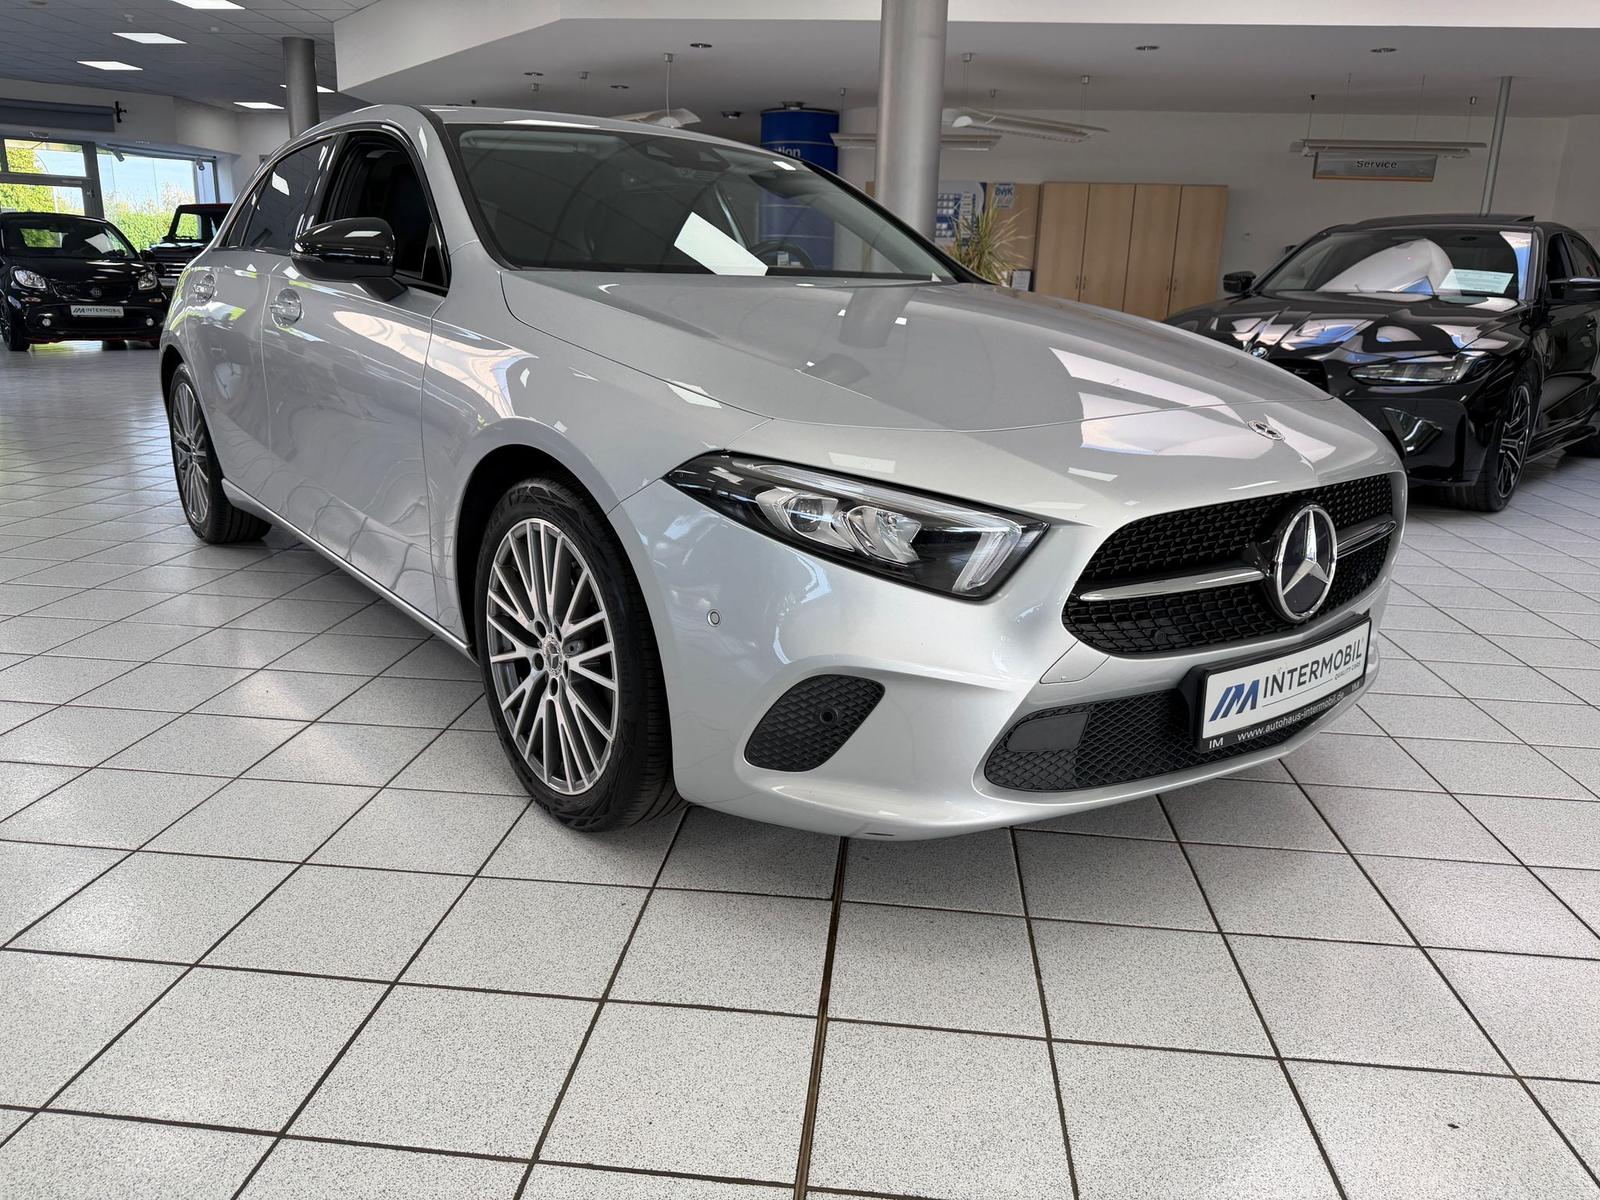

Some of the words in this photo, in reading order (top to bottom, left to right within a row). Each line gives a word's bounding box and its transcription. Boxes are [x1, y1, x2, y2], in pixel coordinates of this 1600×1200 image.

[1356, 160, 1398, 169] Service
[1263, 639, 1362, 698] INTERMOBIL
[1208, 736, 1224, 749] IM
